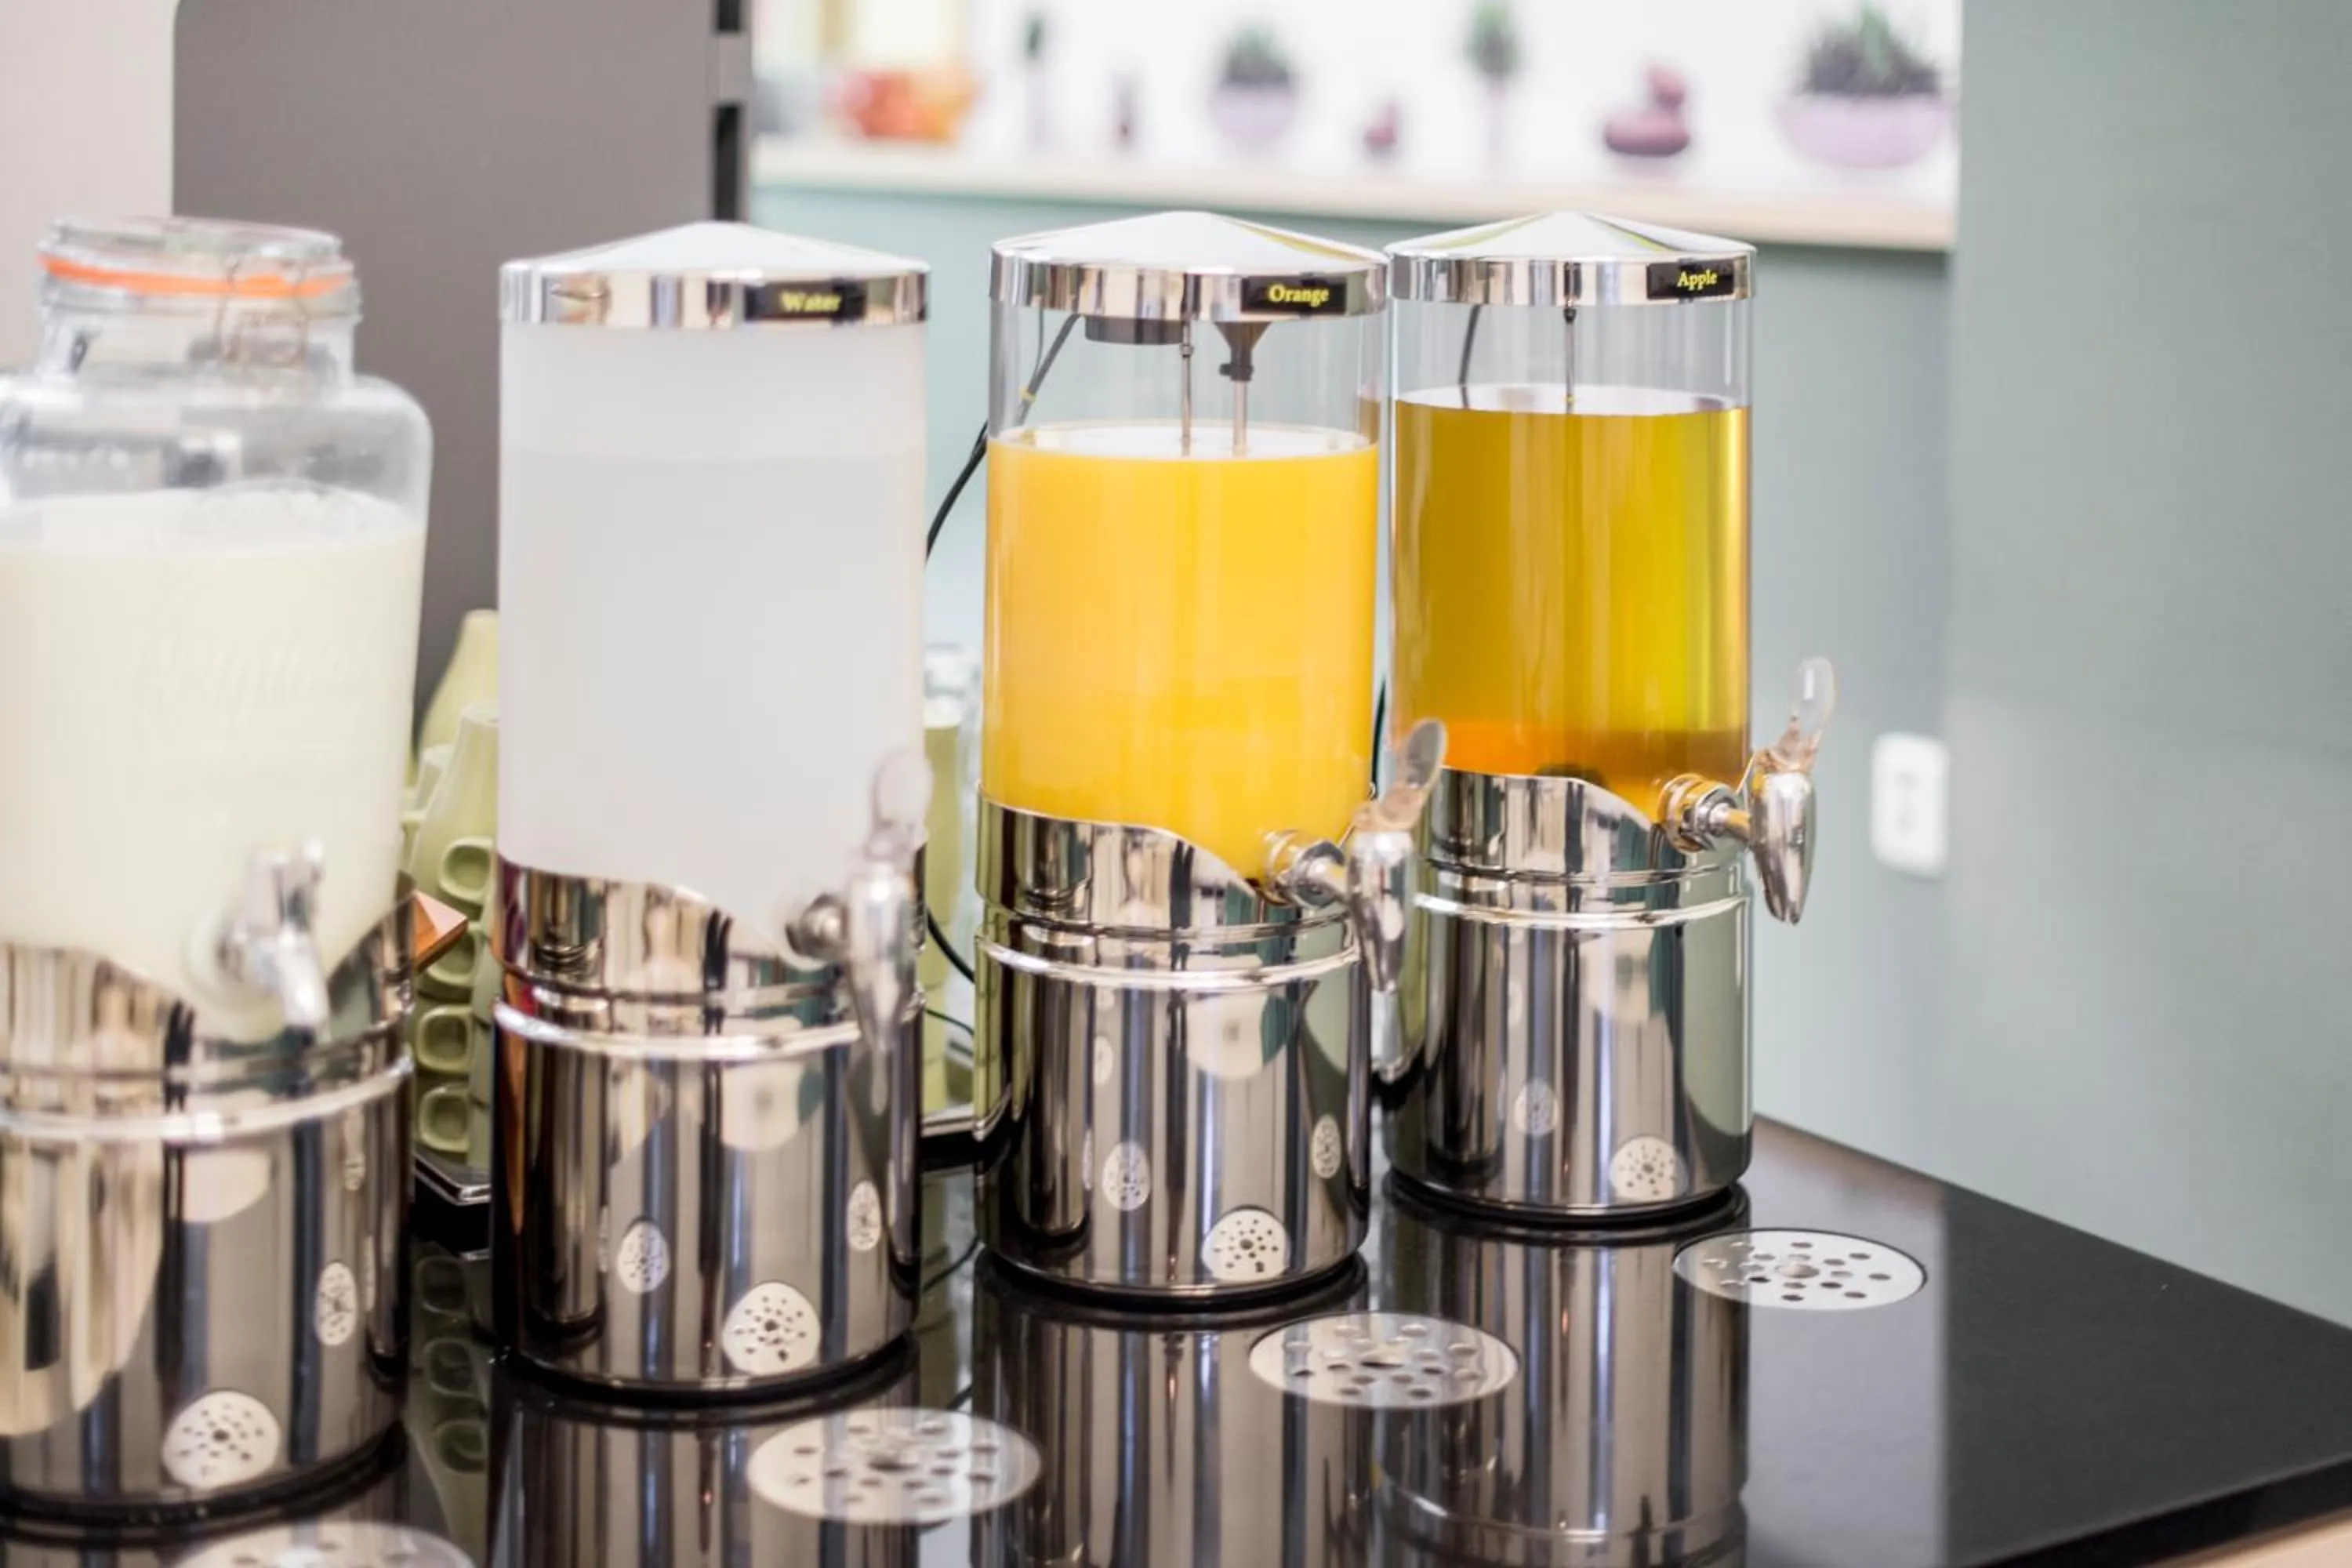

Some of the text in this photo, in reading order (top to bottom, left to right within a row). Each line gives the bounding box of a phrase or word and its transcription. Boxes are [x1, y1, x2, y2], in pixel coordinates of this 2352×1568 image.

[1676, 269, 1718, 291] Apple
[780, 291, 842, 312] Water
[1268, 283, 1330, 307] Orange
